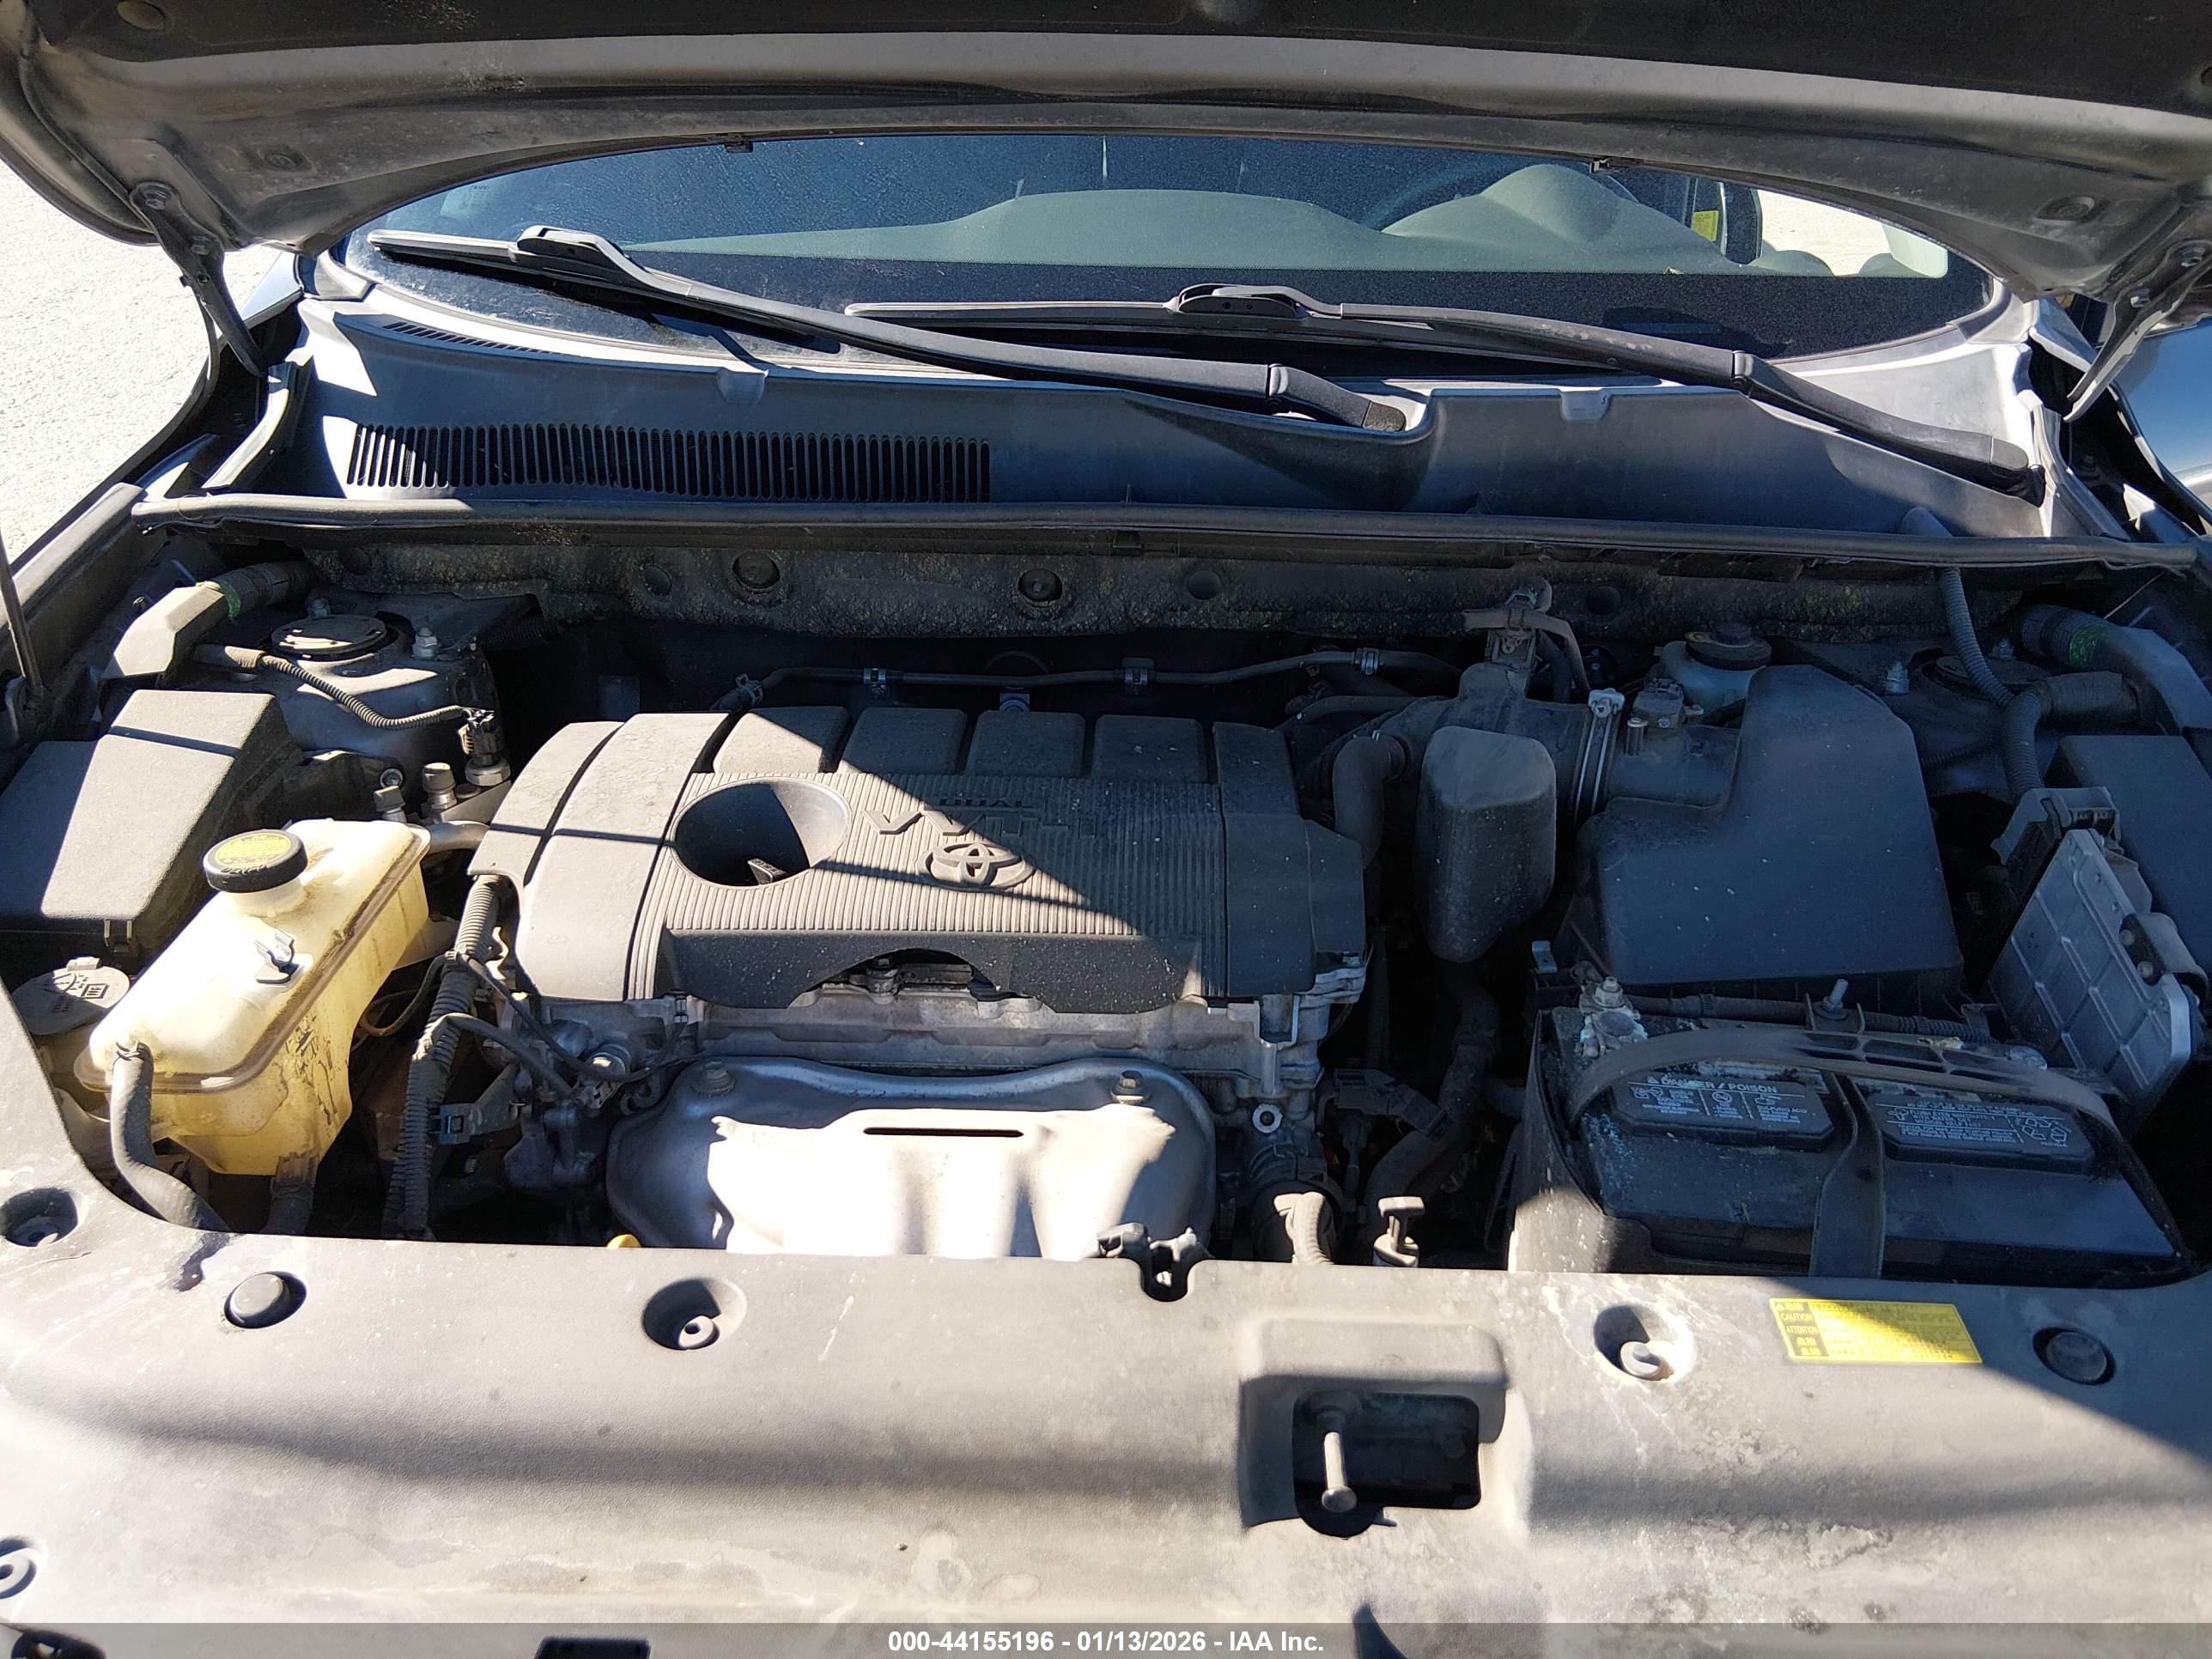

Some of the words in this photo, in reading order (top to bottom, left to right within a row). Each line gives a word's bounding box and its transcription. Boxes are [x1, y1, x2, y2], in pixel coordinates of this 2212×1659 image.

[939, 798, 1034, 809] DUAL
[1661, 1076, 1716, 1089] DANER
[1728, 1084, 1778, 1094] POISON
[1780, 1312, 1814, 1322] CAUTION
[1785, 1326, 1820, 1334] ATTENTION
